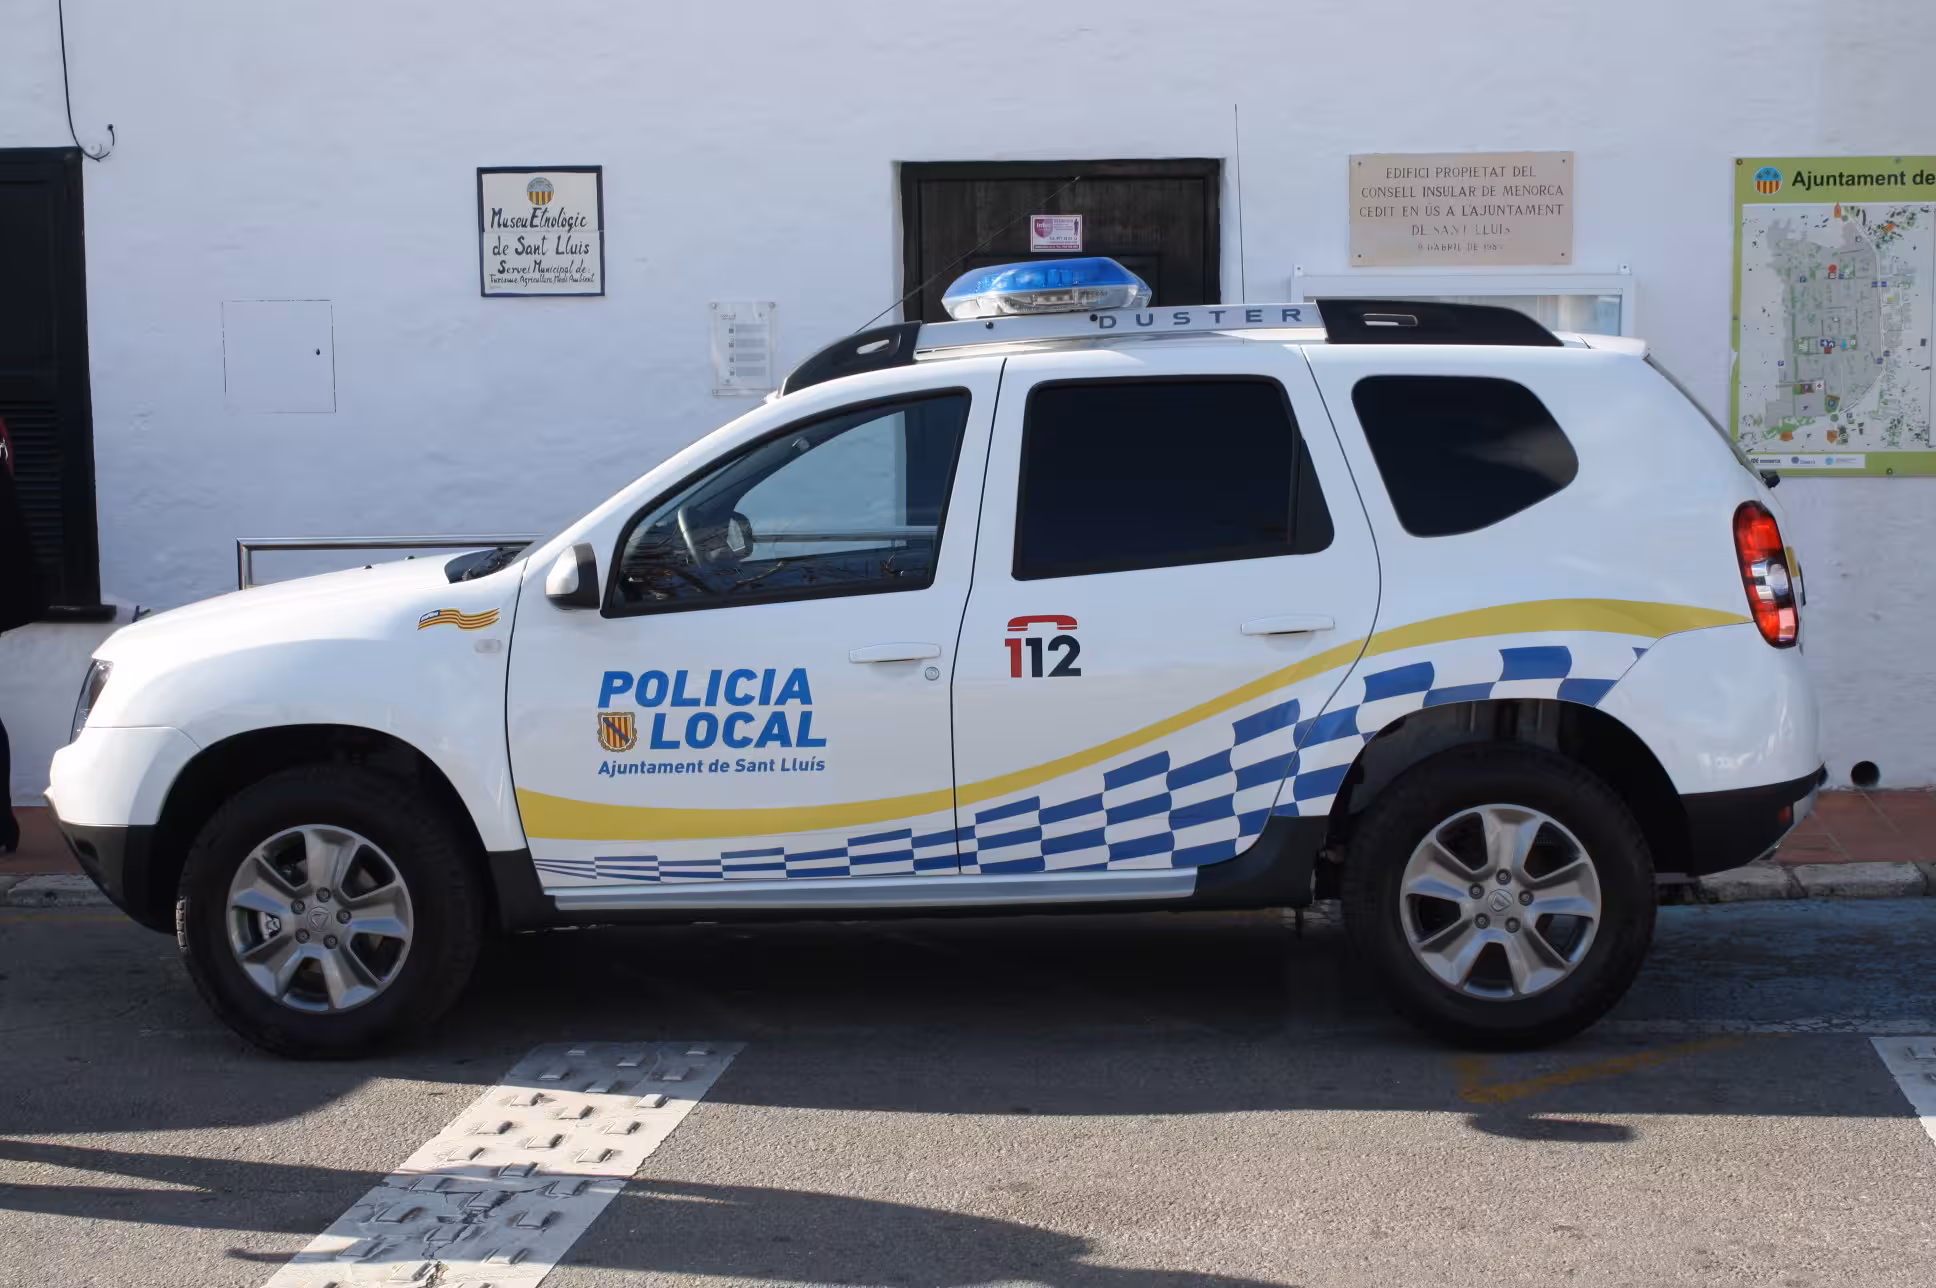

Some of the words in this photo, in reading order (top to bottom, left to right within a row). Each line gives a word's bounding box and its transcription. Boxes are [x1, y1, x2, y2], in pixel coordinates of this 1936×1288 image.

[1386, 167, 1430, 179] EDIFICI
[1435, 166, 1506, 178] PROPIETAT
[1512, 166, 1537, 178] DEL
[1792, 171, 1906, 191] Ajuntament
[1912, 169, 1936, 186] de
[1361, 187, 1417, 199] CONSELL
[1422, 186, 1477, 198] INSULAR
[1481, 185, 1498, 197] DE
[1502, 184, 1564, 197] MENORCA
[490, 208, 529, 229] Museu
[1359, 206, 1396, 218] CEDIT
[1402, 205, 1419, 217] EN
[1445, 205, 1456, 217] A
[492, 236, 509, 256] de
[514, 235, 548, 256] Sant
[497, 259, 531, 275] Servei
[532, 259, 574, 276] Municipal
[1099, 308, 1302, 330] DUSTER
[1004, 634, 1082, 679] 112
[598, 668, 813, 709] POLICIA
[650, 711, 827, 750] LOCAL
[598, 759, 703, 778] Ajuntament
[708, 759, 730, 774] de
[734, 758, 775, 773] Sant
[780, 756, 826, 772] Lluís
